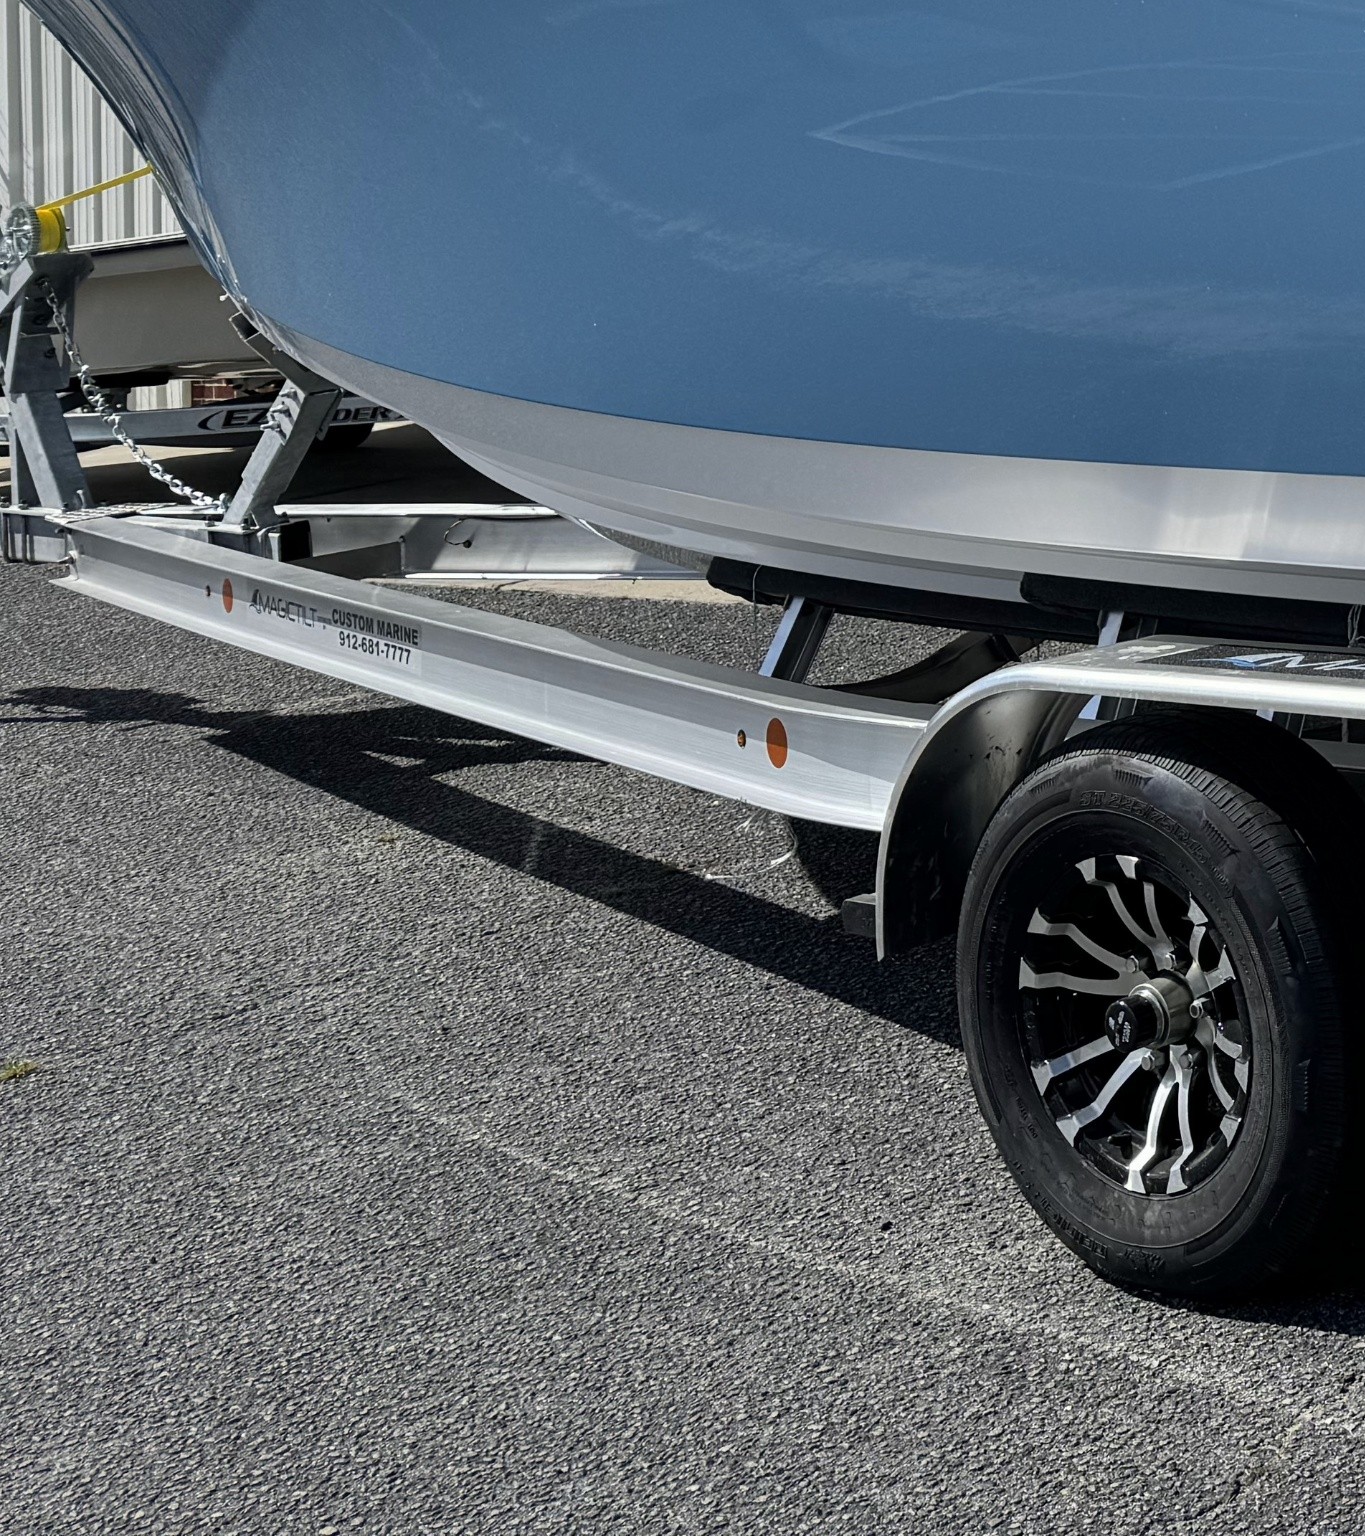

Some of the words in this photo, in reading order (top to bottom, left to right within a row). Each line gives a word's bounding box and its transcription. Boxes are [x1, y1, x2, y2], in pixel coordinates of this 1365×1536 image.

[331, 608, 374, 634] CUSTOM
[376, 619, 419, 646] MARINE
[338, 630, 412, 665] 912-681-7777
